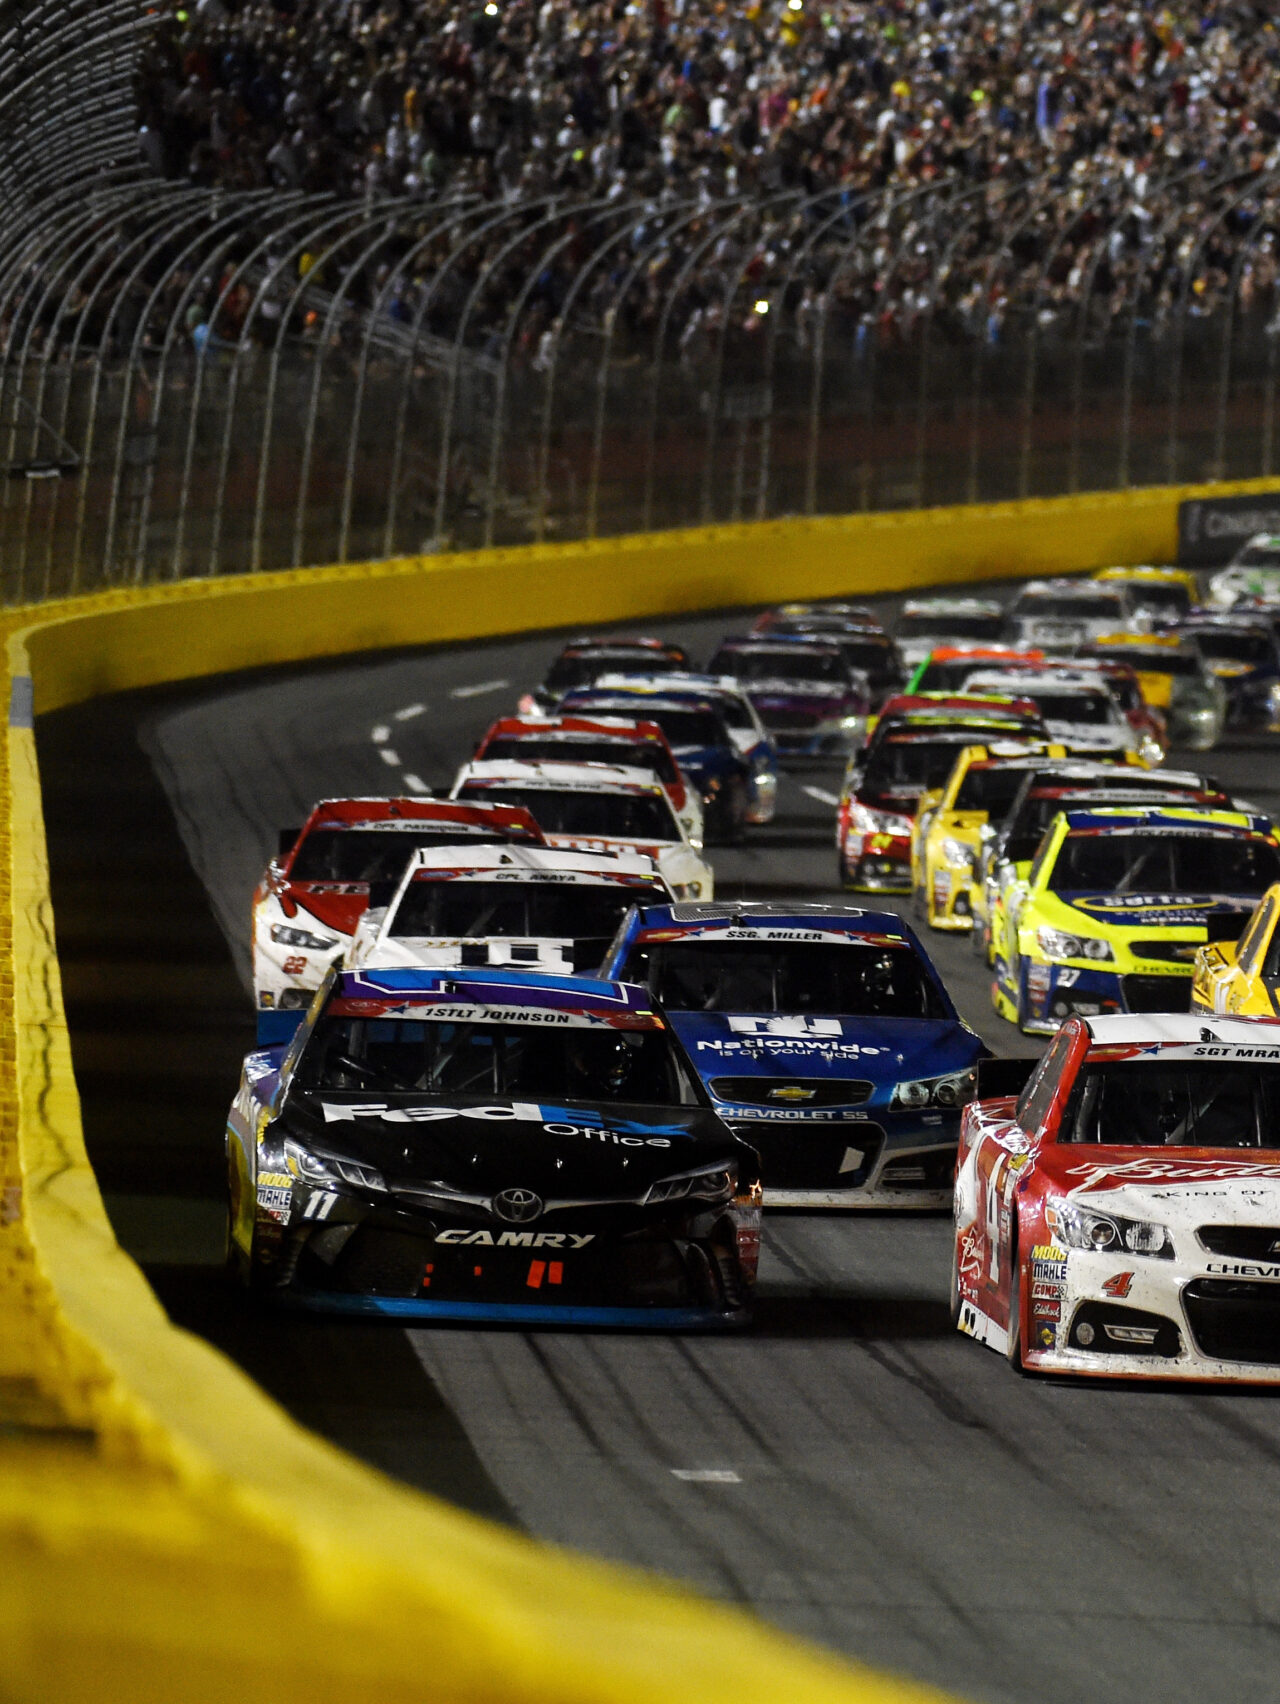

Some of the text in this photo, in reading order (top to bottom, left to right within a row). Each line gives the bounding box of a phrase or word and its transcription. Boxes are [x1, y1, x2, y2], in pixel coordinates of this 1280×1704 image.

[529, 873, 577, 882] ANAYA
[767, 931, 823, 941] MILLER
[282, 955, 308, 975] 22
[1055, 968, 1081, 988] 27
[425, 1006, 570, 1024] 1STLT JOHNSON
[697, 1038, 882, 1056] Nationwide
[1193, 1046, 1233, 1058] SGT
[321, 1102, 695, 1140] FedEx
[842, 1111, 869, 1120] SS
[543, 1123, 672, 1148] Office
[257, 1189, 291, 1206] MAHLE
[1165, 1190, 1228, 1199] KING
[303, 1189, 339, 1221] 11
[434, 1229, 597, 1249] CAMRY
[1031, 1244, 1068, 1261] MOOG
[1033, 1262, 1067, 1280] MAHLE
[1101, 1271, 1136, 1299] 4
